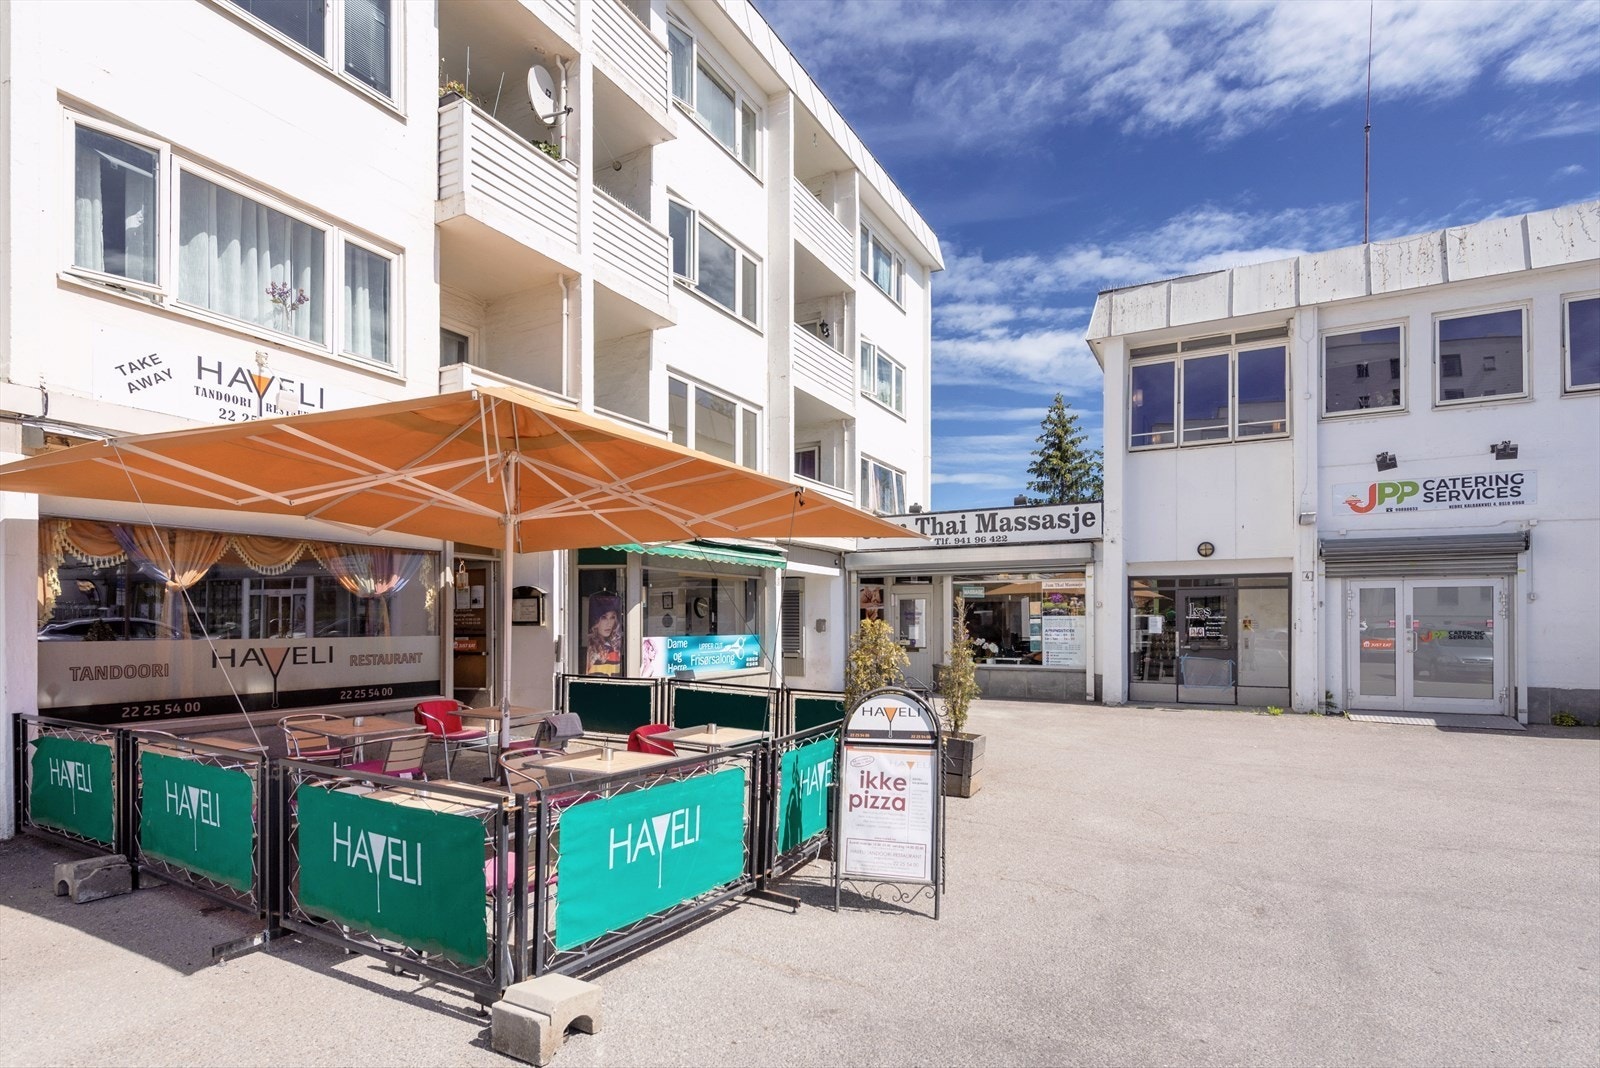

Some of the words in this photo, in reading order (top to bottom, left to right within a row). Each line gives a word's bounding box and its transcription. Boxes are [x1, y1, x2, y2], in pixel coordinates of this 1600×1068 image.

[115, 353, 163, 378] TAKE
[127, 367, 174, 394] AWAY
[194, 385, 252, 408] TANDOORI
[219, 407, 236, 422] 22
[1422, 472, 1525, 492] CATERING
[1348, 480, 1419, 514] JPP
[1423, 486, 1522, 504] SERVICES
[915, 515, 968, 537] Thai
[975, 506, 1097, 535] Massasje
[935, 537, 952, 547] Tlf.
[953, 535, 971, 545] 941
[974, 534, 987, 544] 96
[989, 533, 1008, 543] 422
[668, 638, 688, 649] Dame
[211, 645, 335, 684] HAVELI
[348, 651, 424, 668] RESTAURANT
[673, 651, 682, 663] og
[691, 654, 735, 666] Frisørsalong
[69, 663, 169, 682] TANDOORI
[340, 688, 351, 700] 22
[354, 688, 365, 699] 25
[367, 687, 379, 699] 54
[381, 687, 393, 698] 00
[121, 707, 140, 718] 22
[142, 705, 161, 716] 25
[163, 704, 181, 715] 54
[183, 702, 201, 713] 00
[49, 757, 93, 815] HAVELI
[799, 758, 834, 817] HAVE
[860, 770, 907, 792] ikke
[849, 791, 906, 812] pizza
[165, 780, 221, 852] HAVELI
[608, 805, 702, 889] HAVELI
[333, 821, 423, 914] HAVELI
